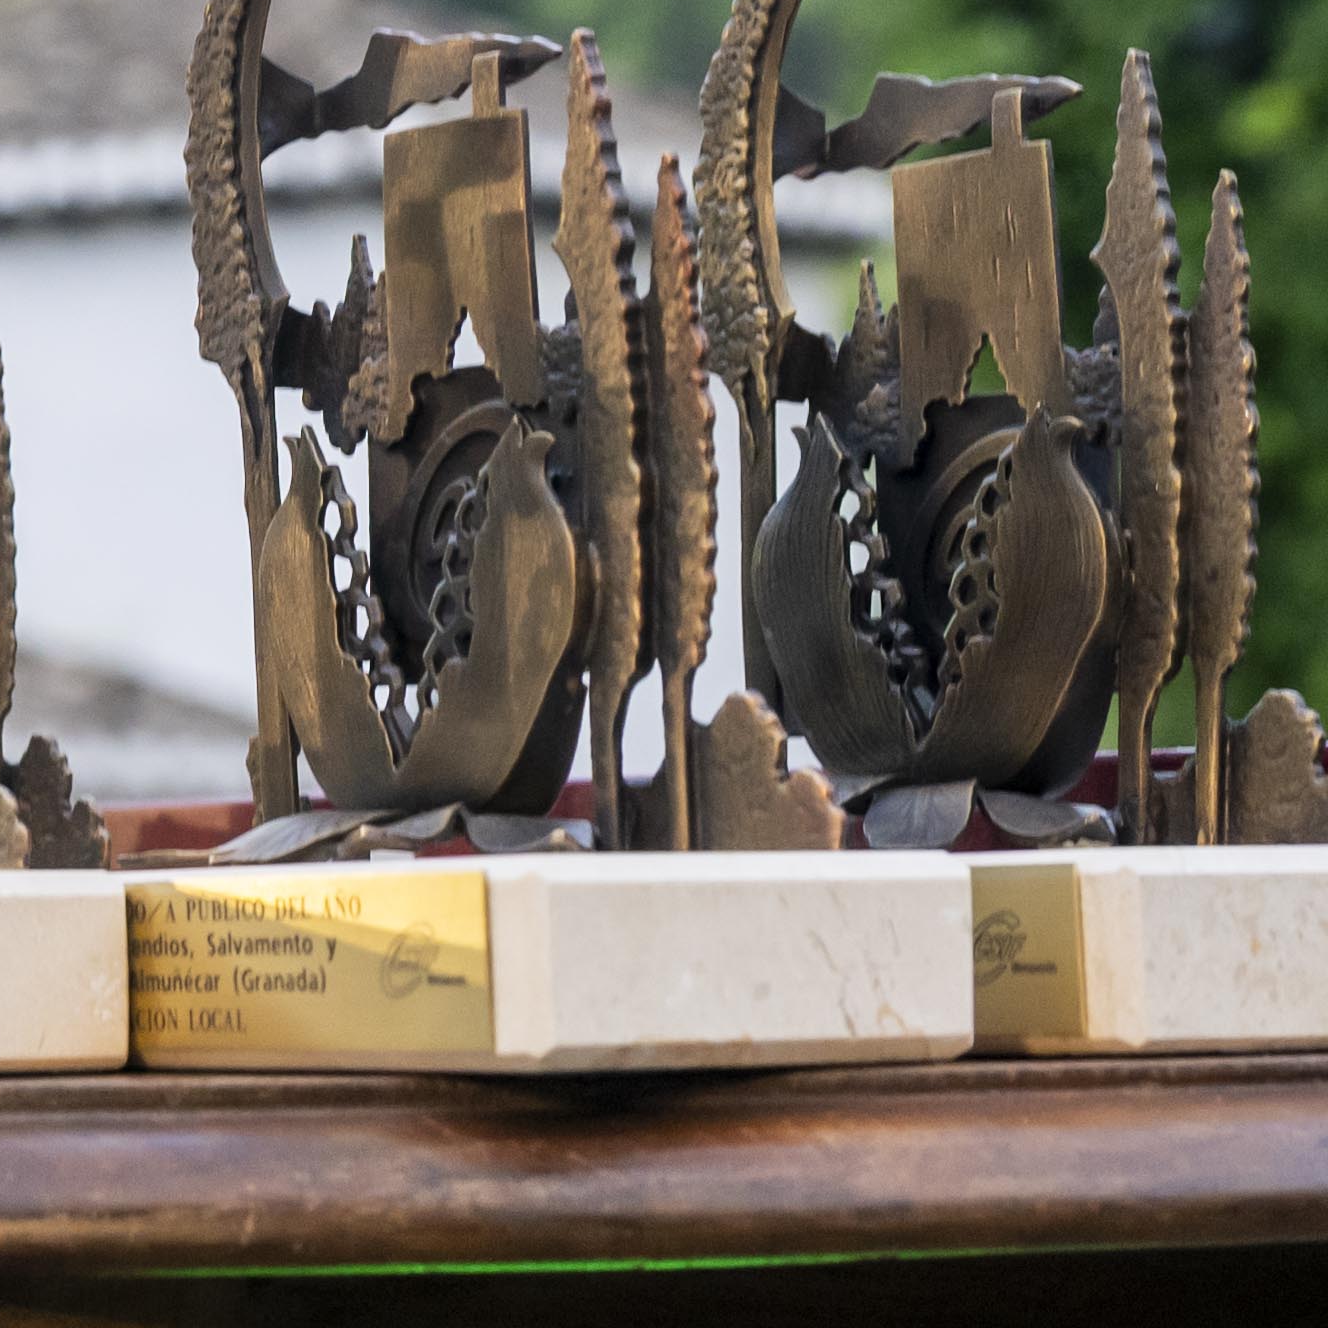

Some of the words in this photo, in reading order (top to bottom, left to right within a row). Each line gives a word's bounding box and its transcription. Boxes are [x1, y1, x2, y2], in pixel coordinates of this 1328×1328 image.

[275, 898, 319, 921] DEL
[322, 894, 362, 919] AÑO
[207, 932, 313, 957] Salvamento
[327, 936, 337, 960] y
[233, 966, 327, 995] (Granada)
[189, 1007, 247, 1033] LOCAL
